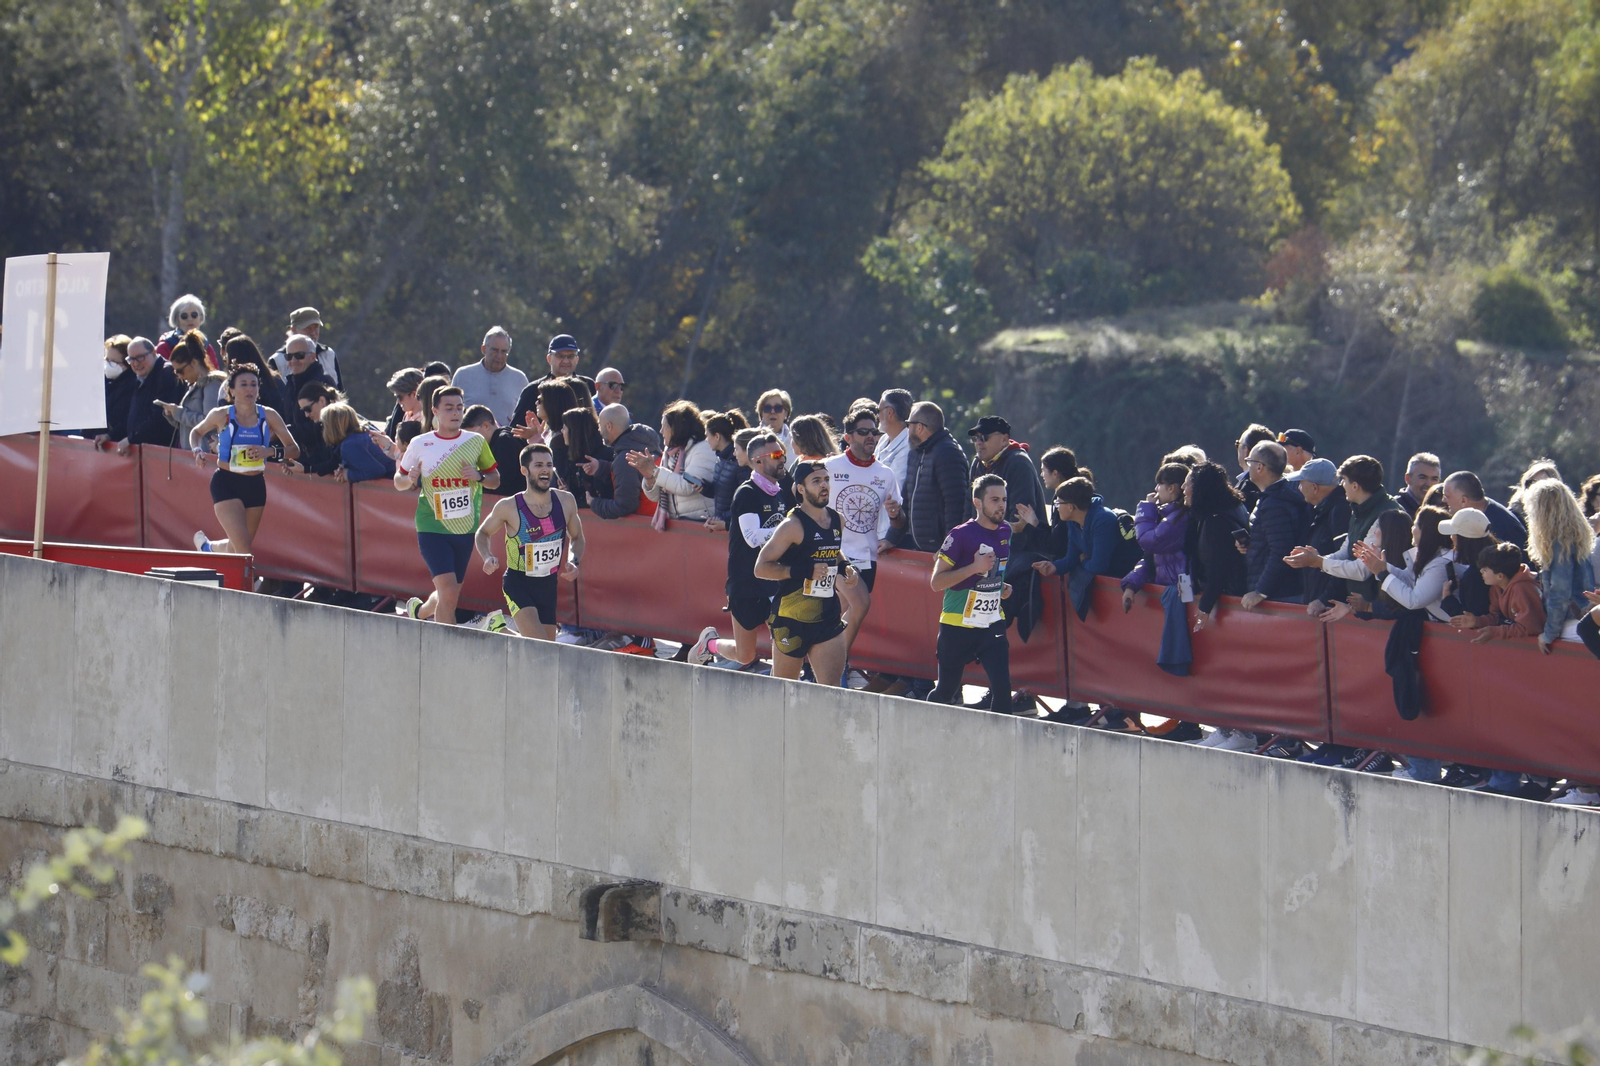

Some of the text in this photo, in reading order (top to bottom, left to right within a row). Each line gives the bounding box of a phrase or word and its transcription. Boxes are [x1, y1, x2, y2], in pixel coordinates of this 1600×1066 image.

[432, 476, 469, 488] ÉLITE
[442, 495, 469, 510] 1655
[534, 546, 560, 562] 1534
[973, 598, 998, 612] 2332
